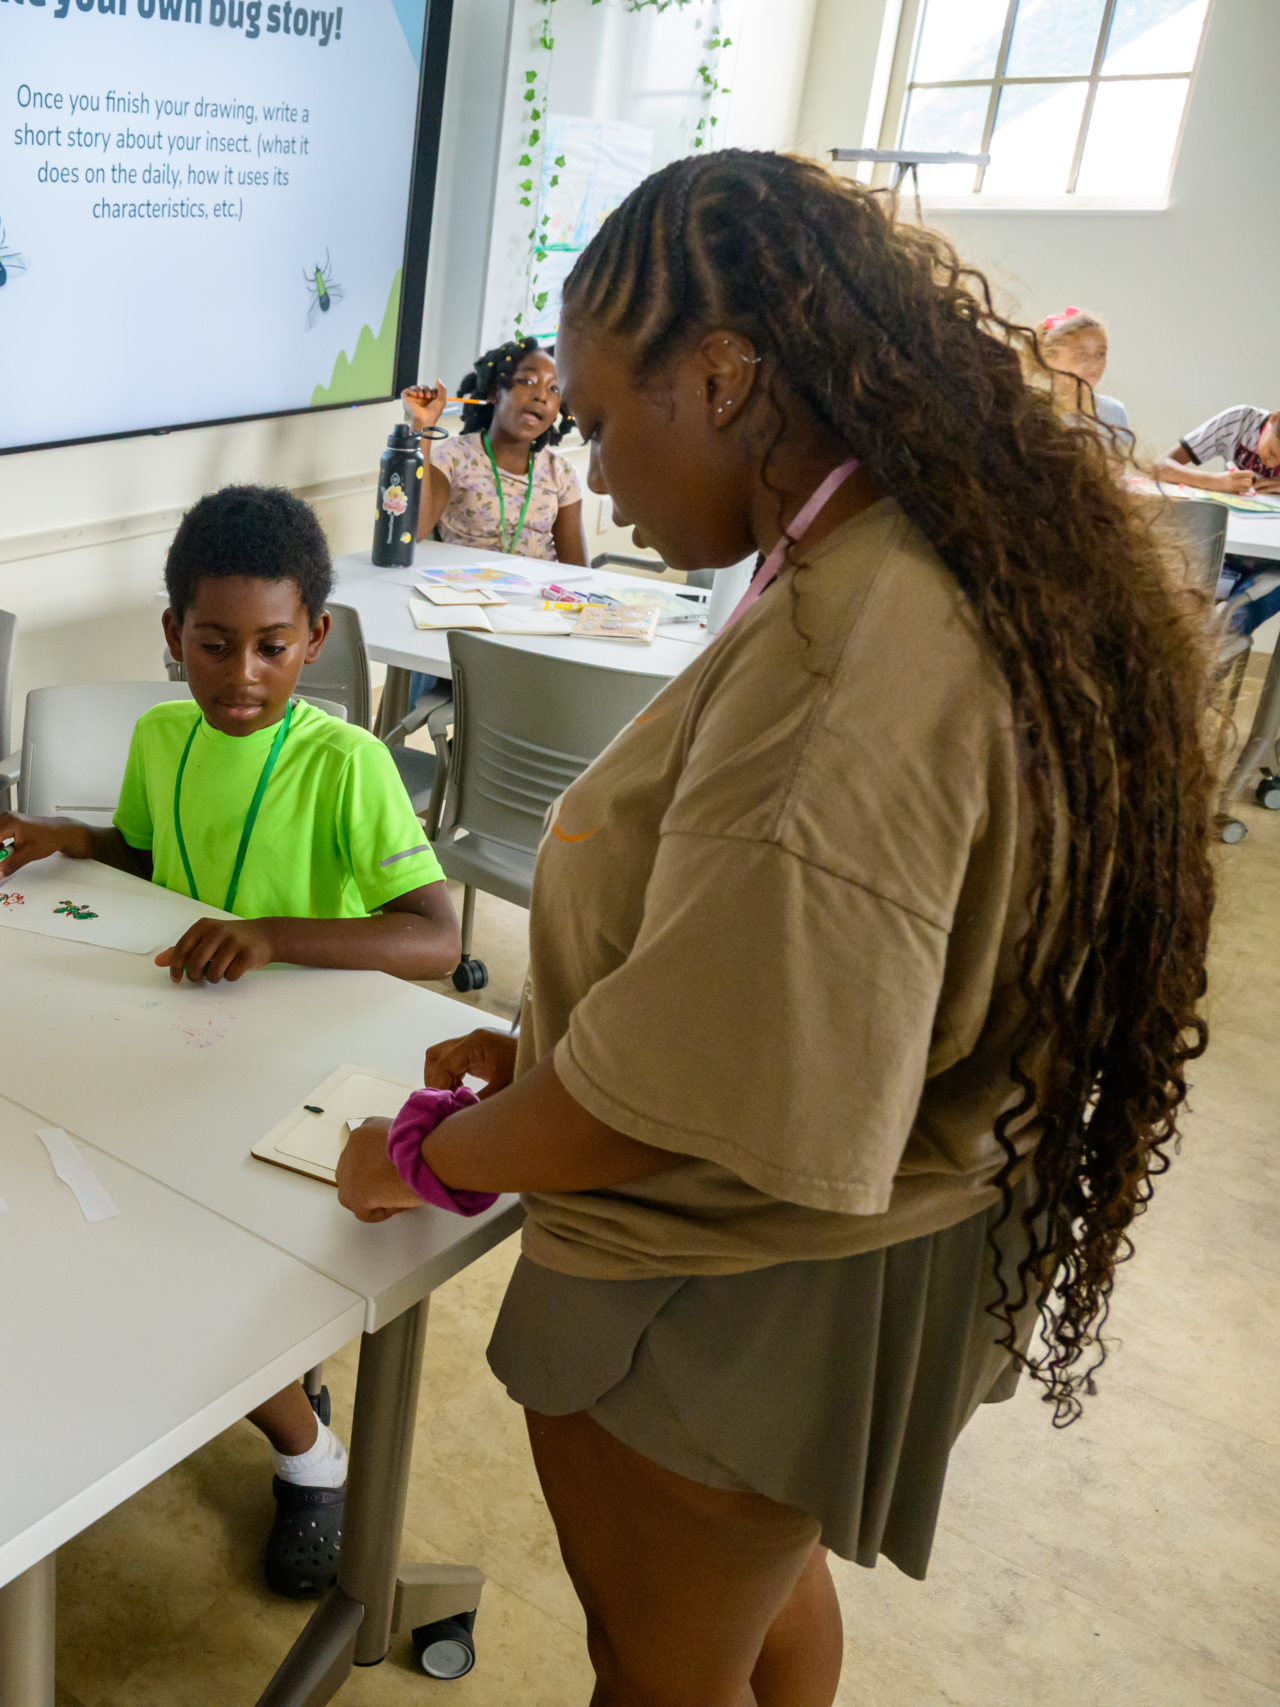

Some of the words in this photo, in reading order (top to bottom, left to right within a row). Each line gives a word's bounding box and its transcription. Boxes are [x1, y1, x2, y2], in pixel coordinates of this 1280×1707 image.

[137, 0, 201, 24] own
[209, 0, 262, 39] bug
[266, 1, 343, 46] story!
[17, 84, 63, 109] Once
[69, 94, 100, 115] you
[106, 90, 150, 114] finish
[155, 98, 190, 120] your
[194, 96, 257, 125] drawing,
[263, 102, 298, 123] write
[301, 108, 309, 123] a
[14, 123, 62, 147] short
[67, 125, 111, 153] story
[116, 127, 163, 150] about
[168, 132, 201, 155] your
[206, 131, 252, 153] insect.
[257, 133, 296, 158] (what
[300, 135, 309, 155] it
[38, 161, 79, 183] does
[85, 166, 106, 183] on
[111, 162, 137, 184] the
[142, 162, 182, 189] daily,
[187, 164, 219, 185] how
[223, 165, 233, 185] it
[238, 170, 269, 186] uses
[273, 166, 289, 186] its
[92, 197, 208, 220] characteristics,
[213, 197, 243, 222] etc.)
